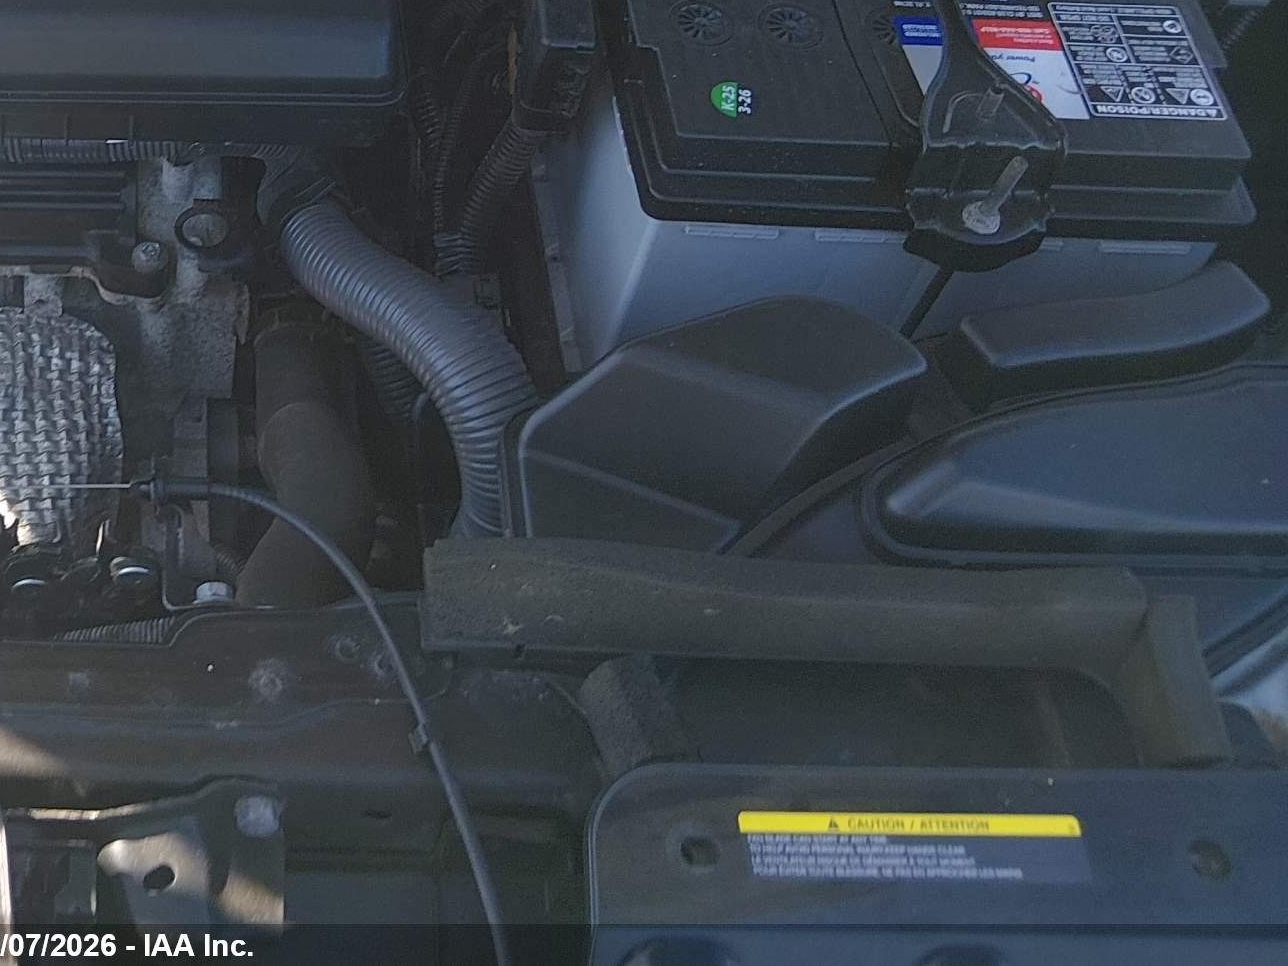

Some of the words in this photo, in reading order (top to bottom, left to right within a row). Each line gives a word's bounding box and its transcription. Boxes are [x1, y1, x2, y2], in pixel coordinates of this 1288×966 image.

[720, 85, 736, 111] K-25
[737, 89, 752, 115] 3-26
[1096, 104, 1206, 118] DANGER/POISON
[847, 817, 906, 831] CAUTION
[919, 818, 991, 833] ATTENTION
